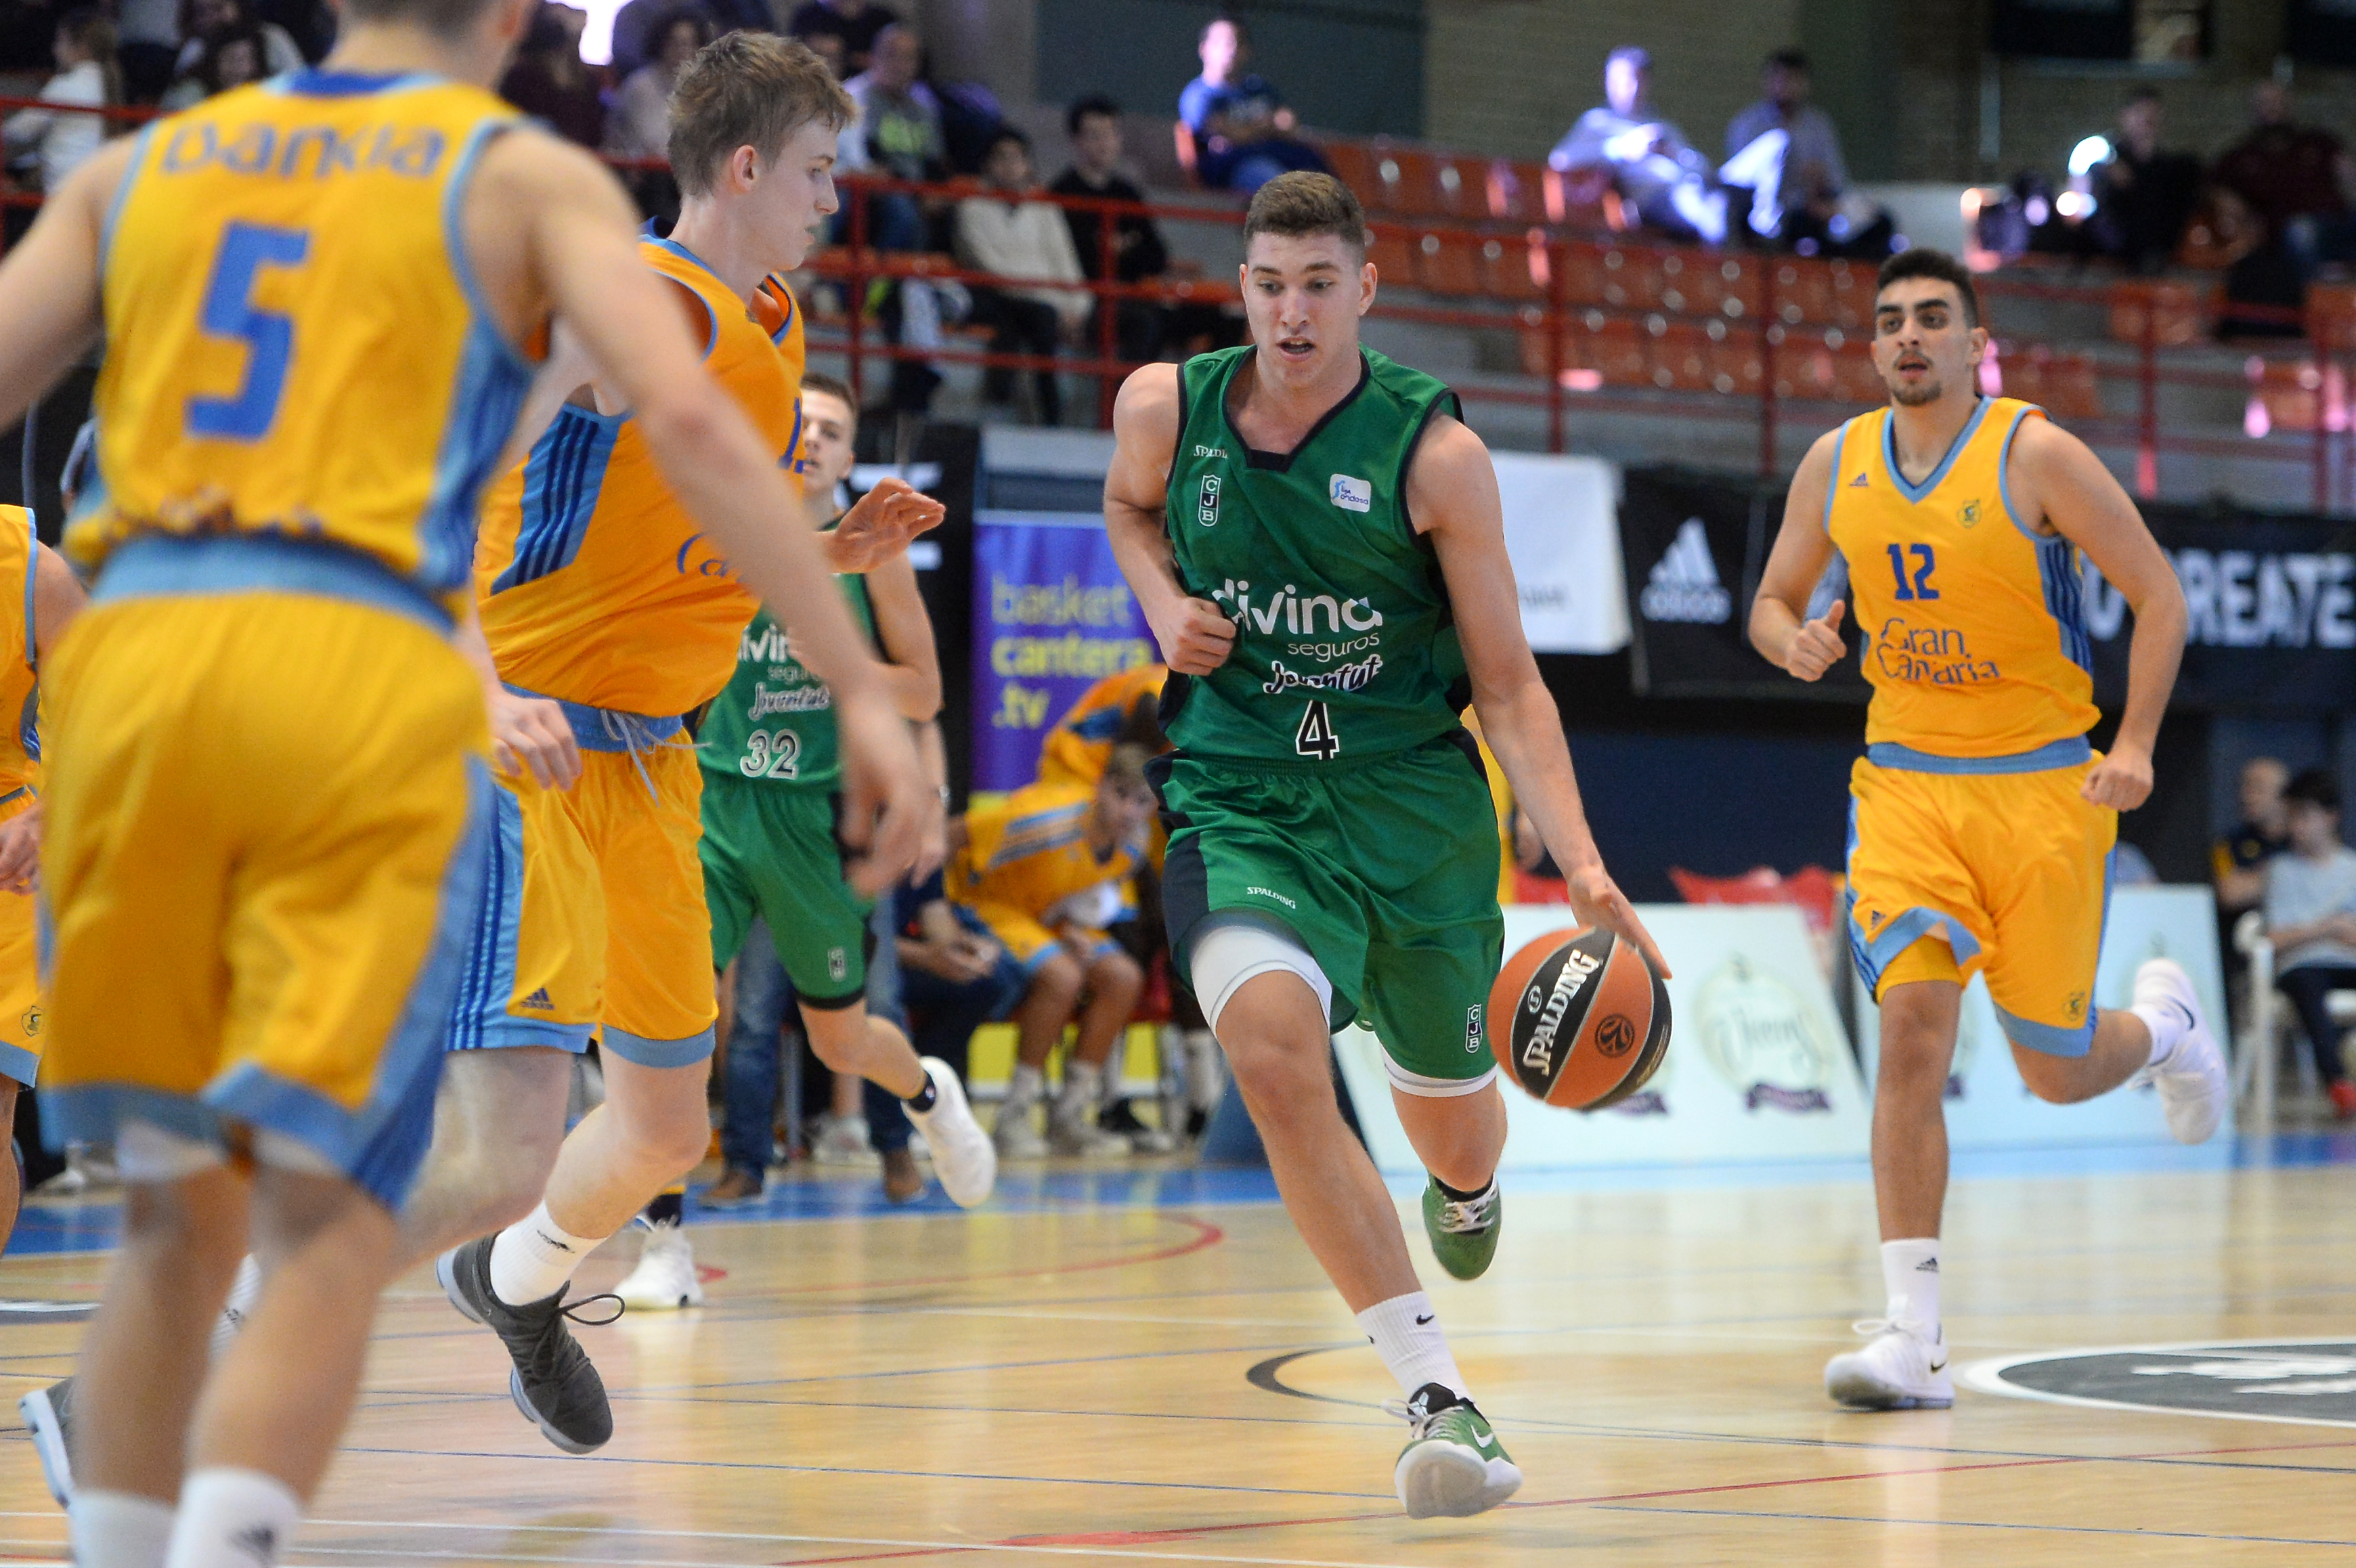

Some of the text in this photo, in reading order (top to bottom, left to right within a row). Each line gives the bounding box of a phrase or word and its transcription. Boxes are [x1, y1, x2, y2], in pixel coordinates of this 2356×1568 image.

[183, 218, 310, 444] 5
[1886, 543, 1940, 601] 12
[2164, 547, 2356, 649] REATE
[991, 571, 1132, 627] basket
[990, 632, 1154, 678] cantera
[1288, 632, 1380, 663] seguros
[1880, 617, 1966, 656] Gran
[1876, 643, 2001, 685] Canaria
[991, 680, 1050, 729] .tv
[1295, 699, 1340, 760] 4
[740, 728, 801, 780] 32
[1247, 886, 1296, 910] SPALDING
[1523, 949, 1600, 1077] SPALDING
